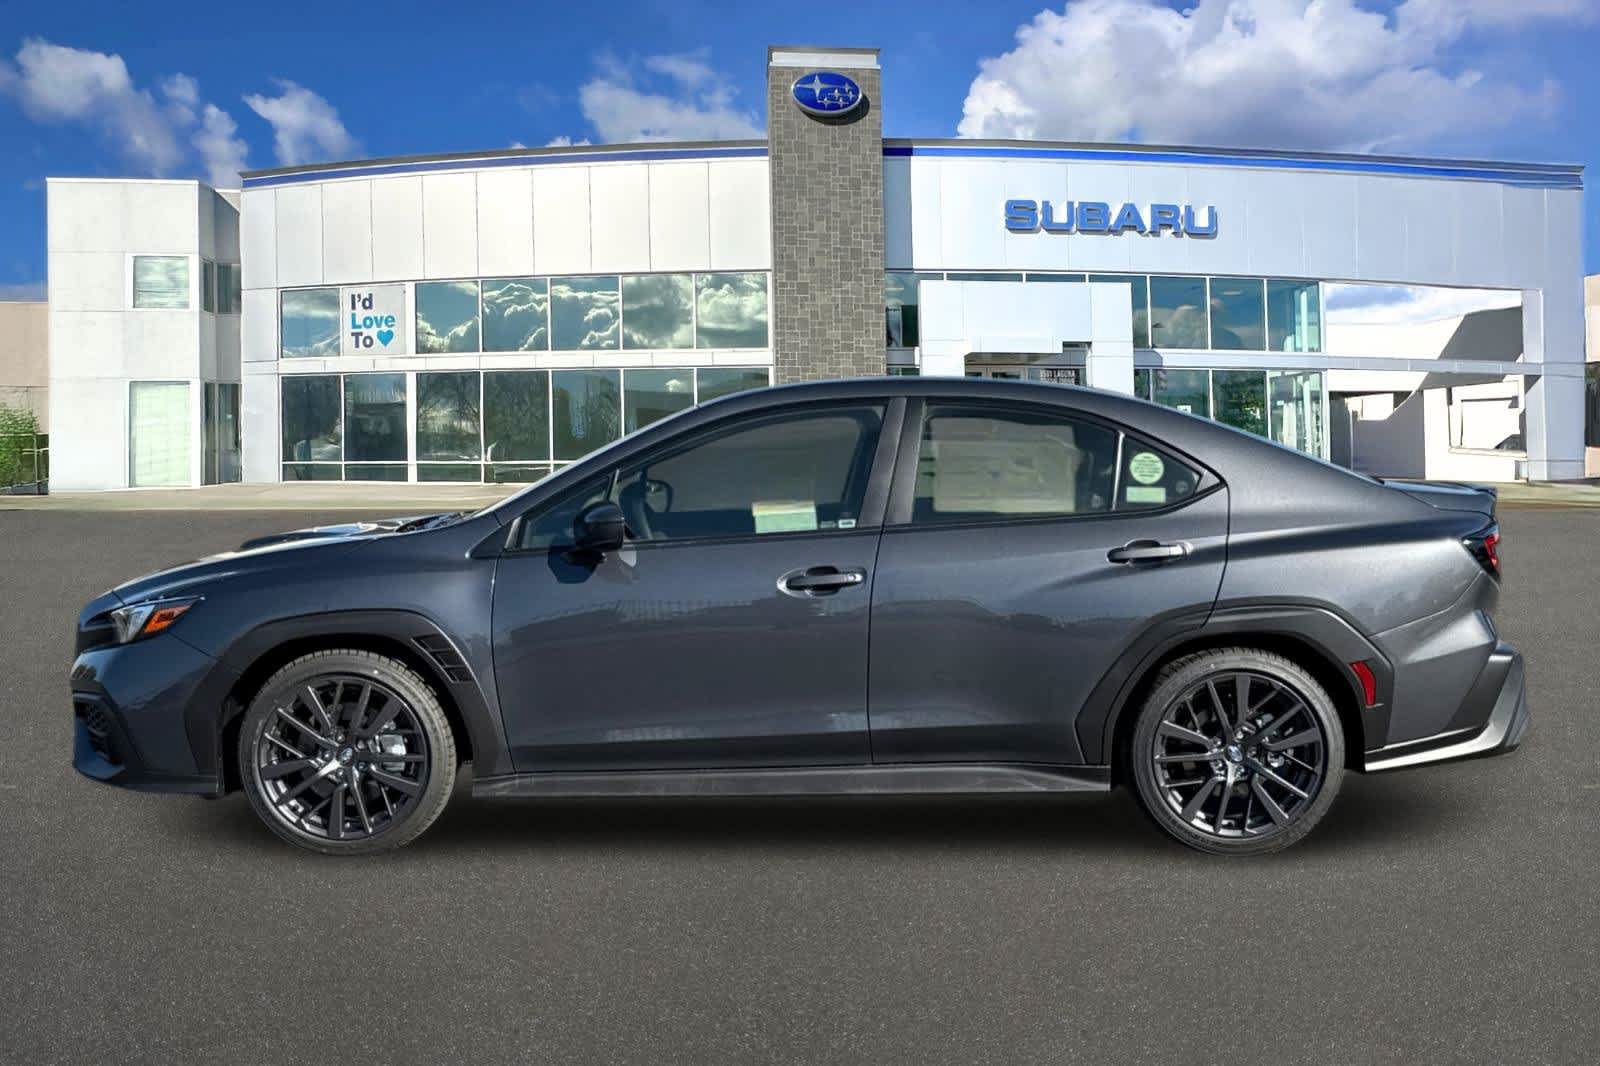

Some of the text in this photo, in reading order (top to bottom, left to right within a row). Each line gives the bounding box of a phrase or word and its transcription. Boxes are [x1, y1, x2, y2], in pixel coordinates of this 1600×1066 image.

[1004, 199, 1217, 238] SUBARU
[350, 293, 373, 311] I'd
[351, 312, 396, 329] Love
[350, 331, 374, 348] To
